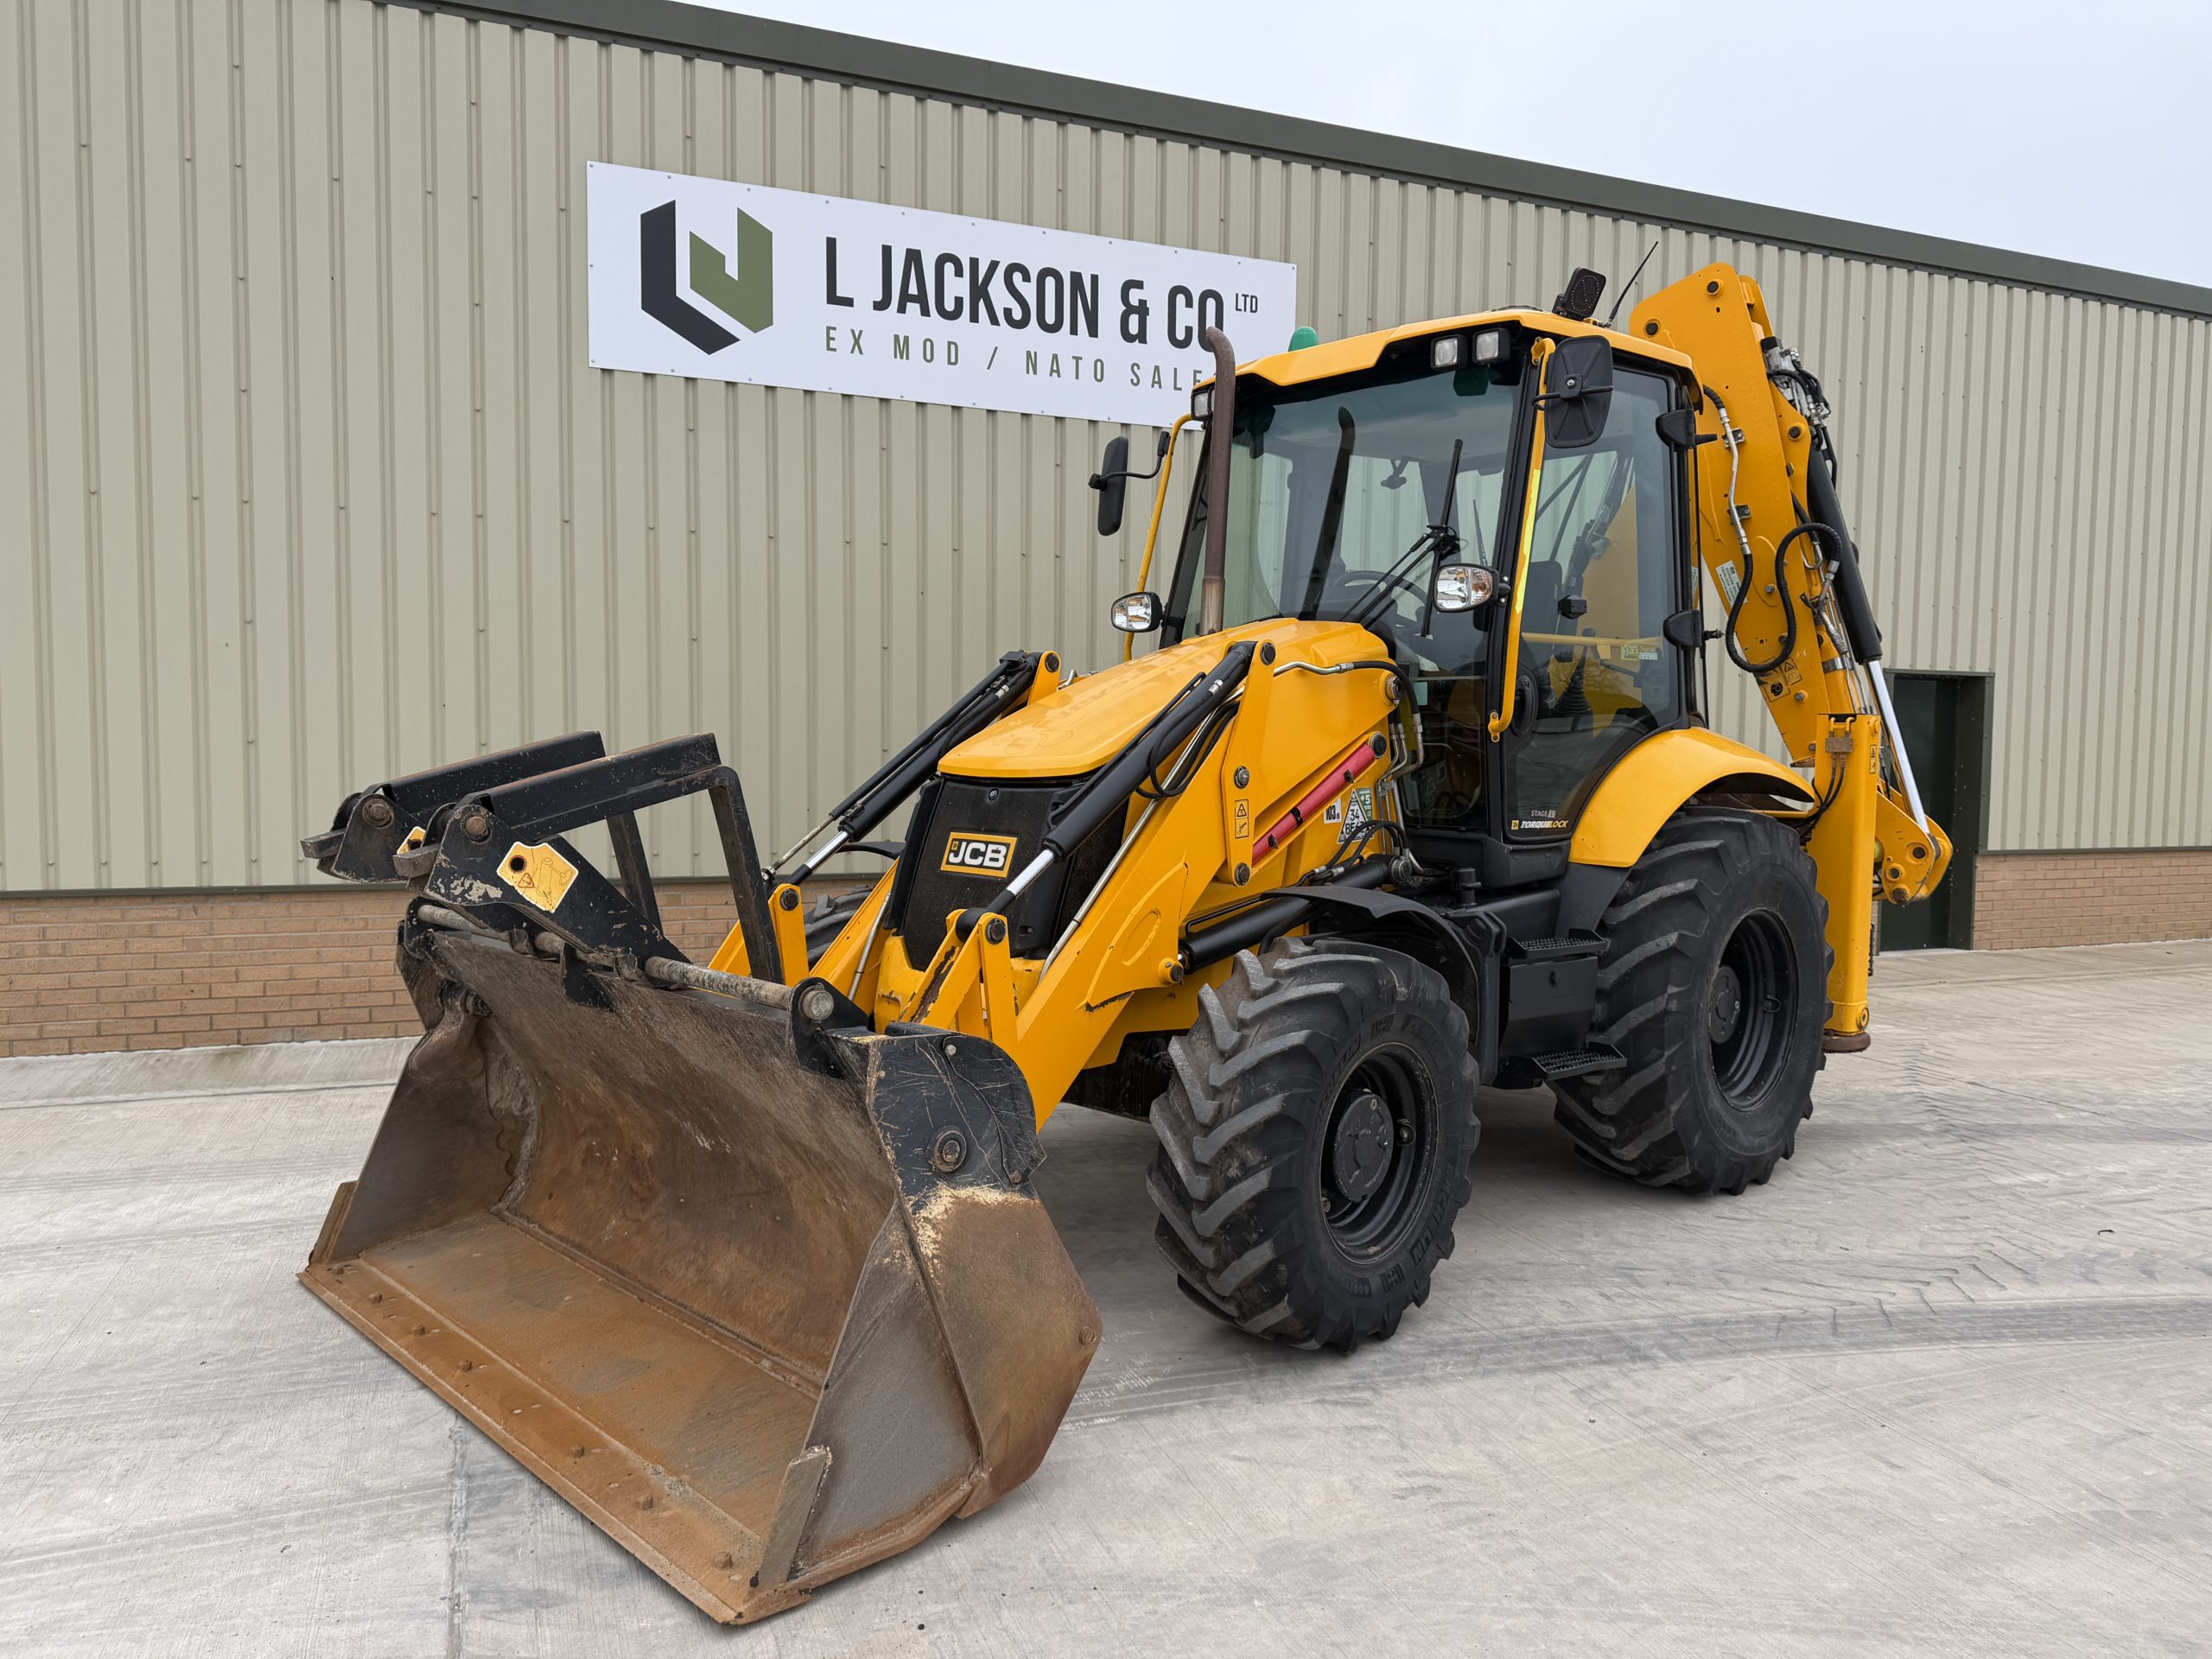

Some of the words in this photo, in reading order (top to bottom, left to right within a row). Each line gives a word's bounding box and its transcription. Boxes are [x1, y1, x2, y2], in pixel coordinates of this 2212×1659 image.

[826, 237, 854, 308] L
[873, 244, 1099, 338] JACKSON
[1120, 279, 1149, 344] &
[1167, 285, 1224, 353] CO
[1235, 293, 1259, 313] LTD
[825, 326, 863, 355] EX
[893, 334, 959, 366] MOD
[987, 346, 998, 370] /
[1026, 350, 1104, 383] NATO
[1130, 362, 1203, 391] SALE
[1521, 820, 1568, 829] TORQUELOCK
[949, 841, 1007, 868] JCB
